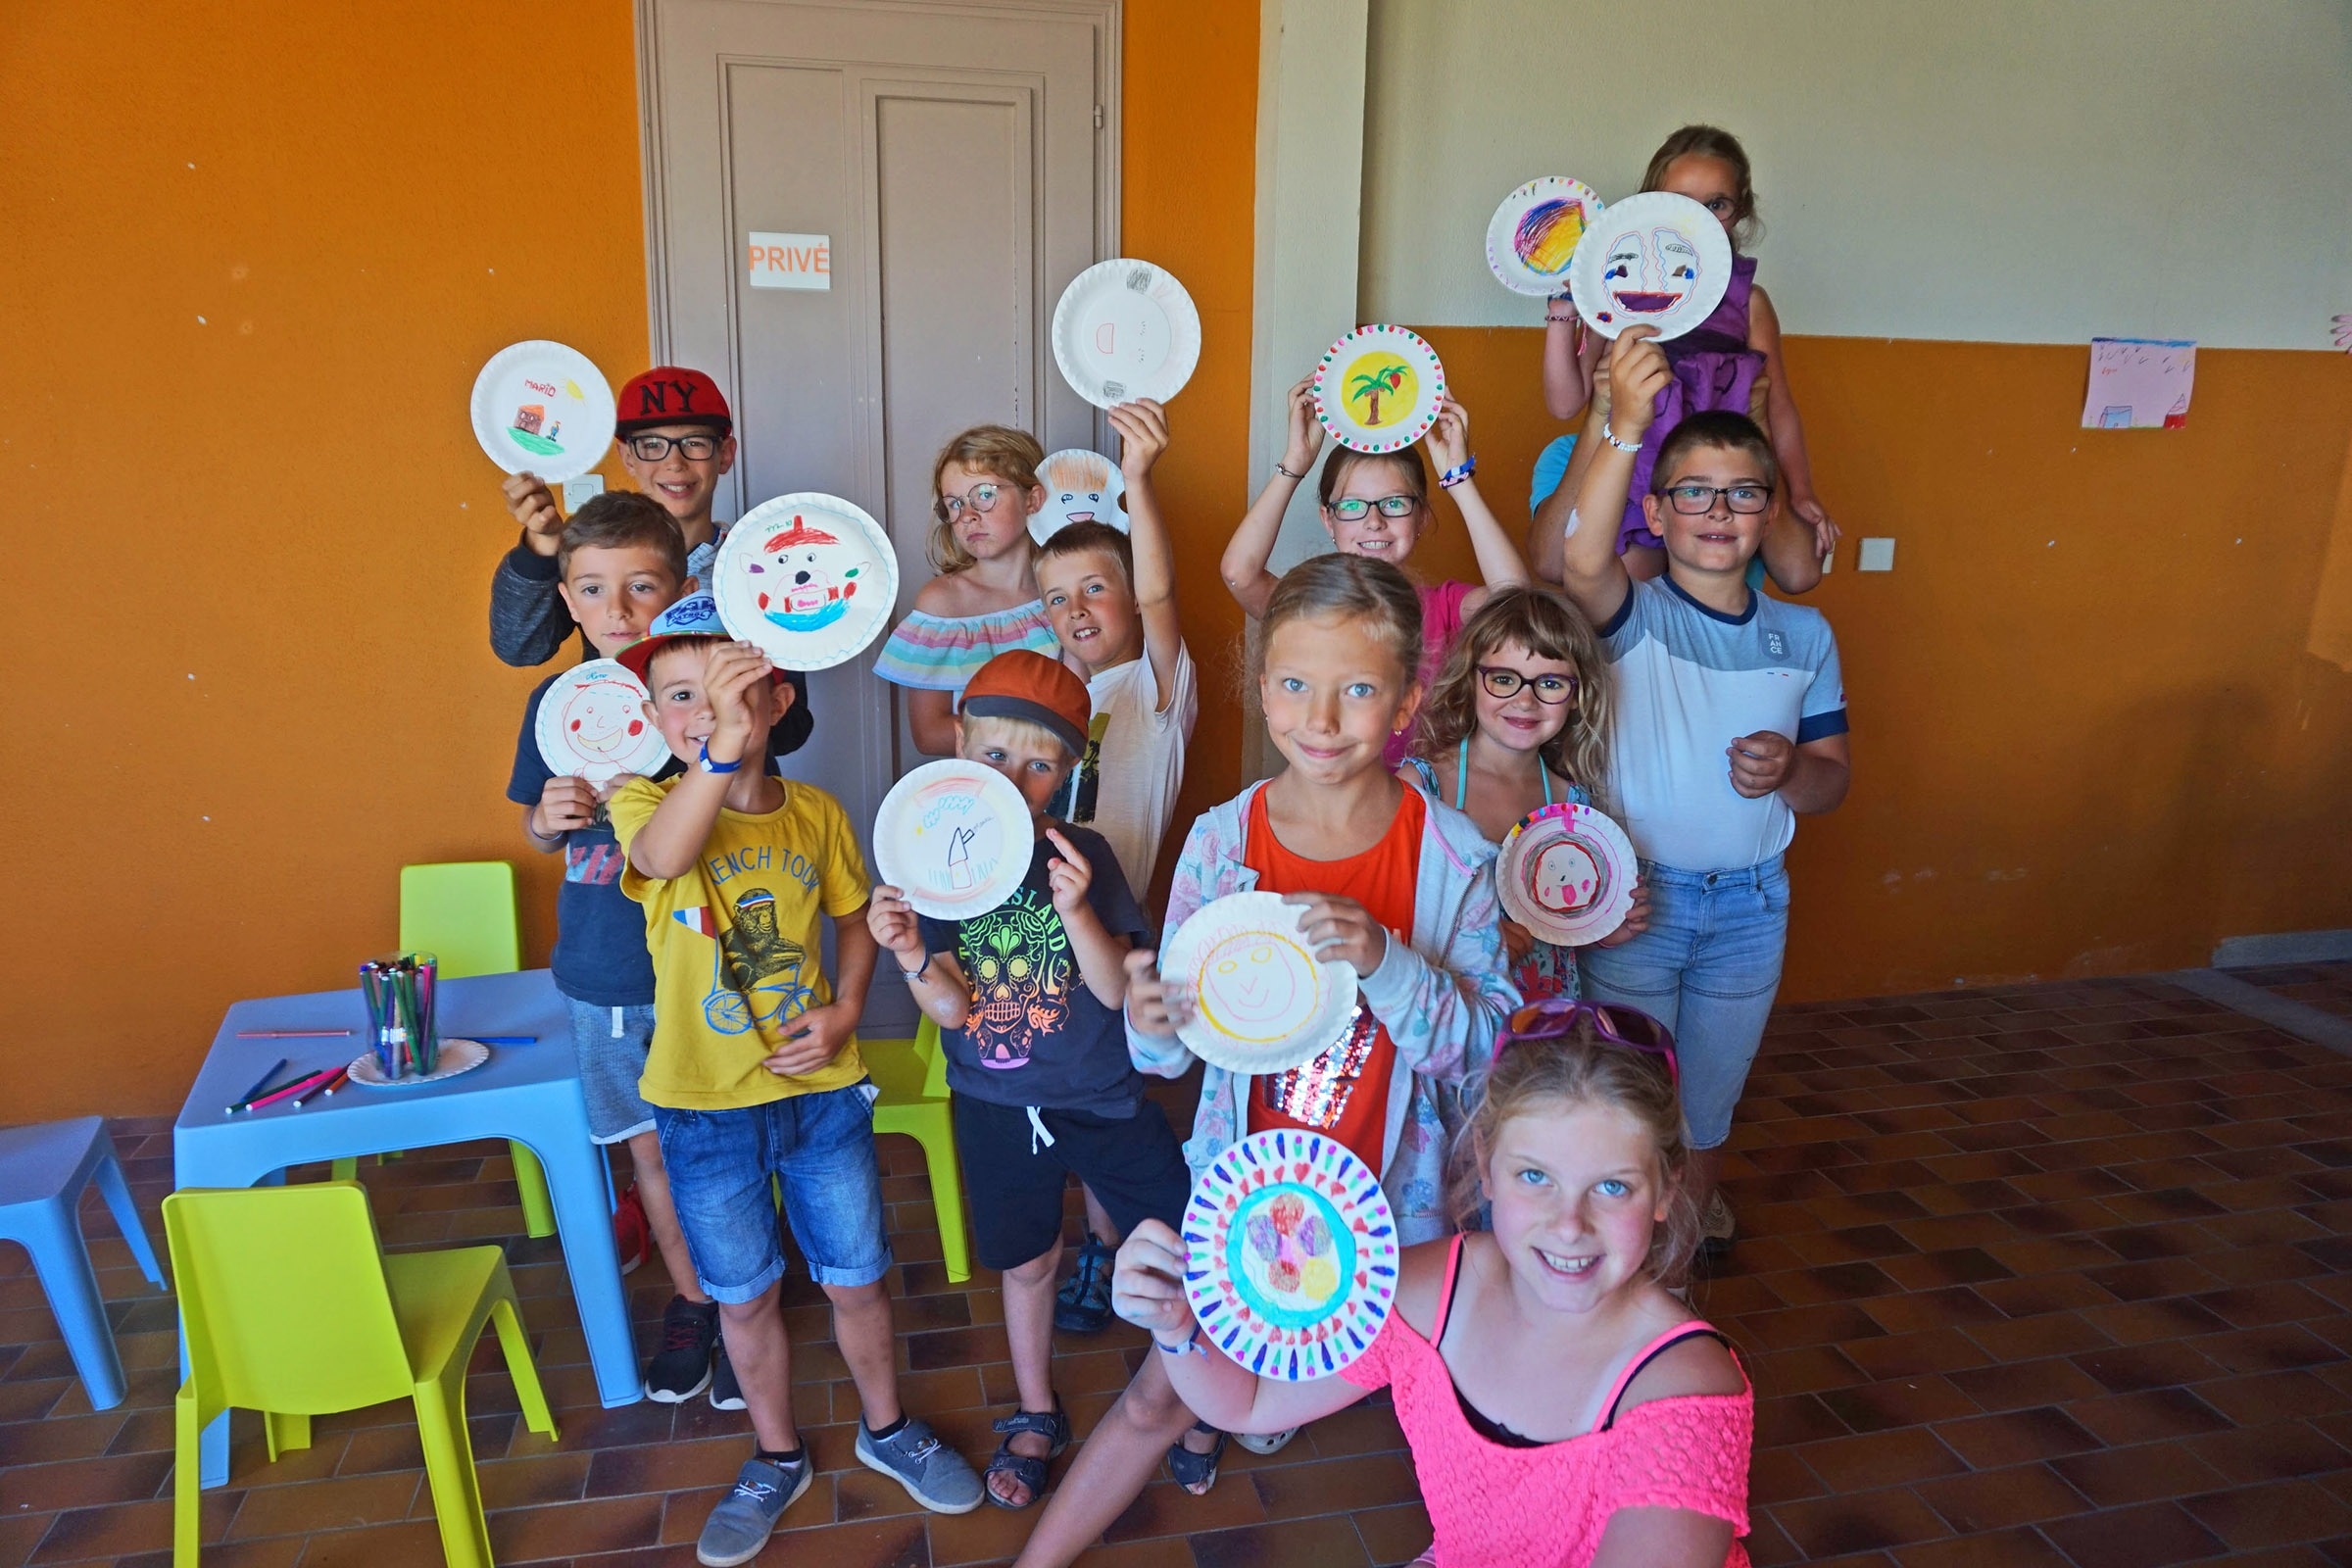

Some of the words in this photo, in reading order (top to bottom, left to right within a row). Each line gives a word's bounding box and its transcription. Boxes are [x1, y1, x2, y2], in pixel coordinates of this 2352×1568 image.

[748, 242, 831, 273] PRIVÉ
[639, 380, 698, 416] NY
[1770, 646, 1784, 655] CE
